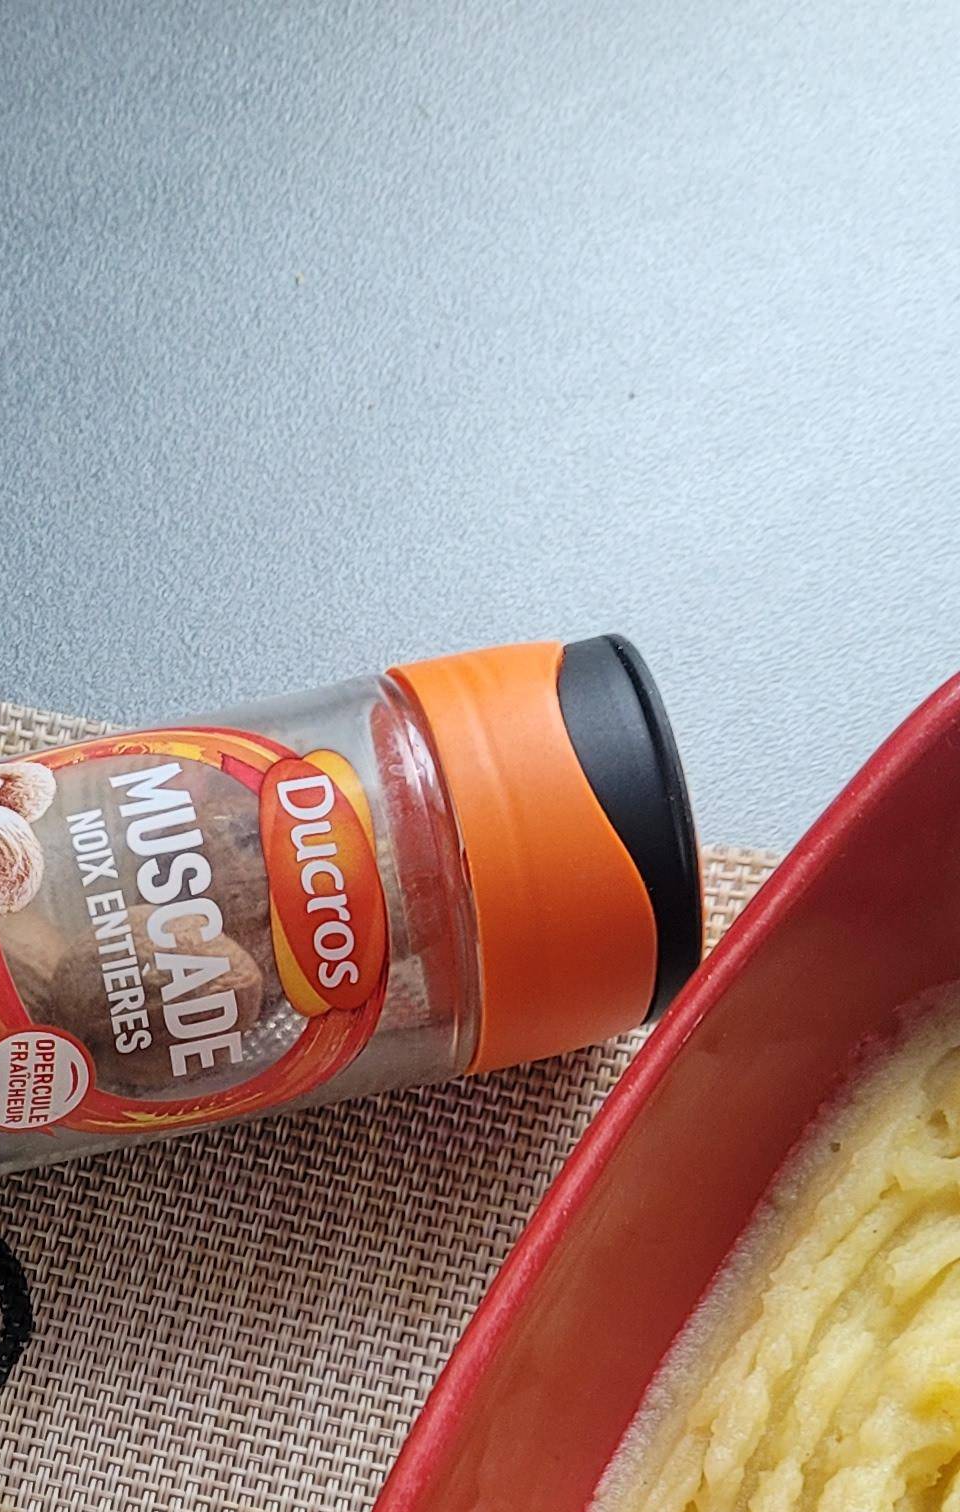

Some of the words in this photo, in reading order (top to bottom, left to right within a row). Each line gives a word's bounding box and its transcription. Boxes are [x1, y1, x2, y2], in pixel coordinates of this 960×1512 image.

[65, 807, 121, 888] NOIX
[276, 773, 360, 989] Ducros
[85, 889, 154, 1055] ENTIÈRES
[108, 761, 244, 1078] MUSCADE
[4, 1041, 32, 1125] FRAÎCHEUR
[28, 1039, 56, 1124] OPERCULE
